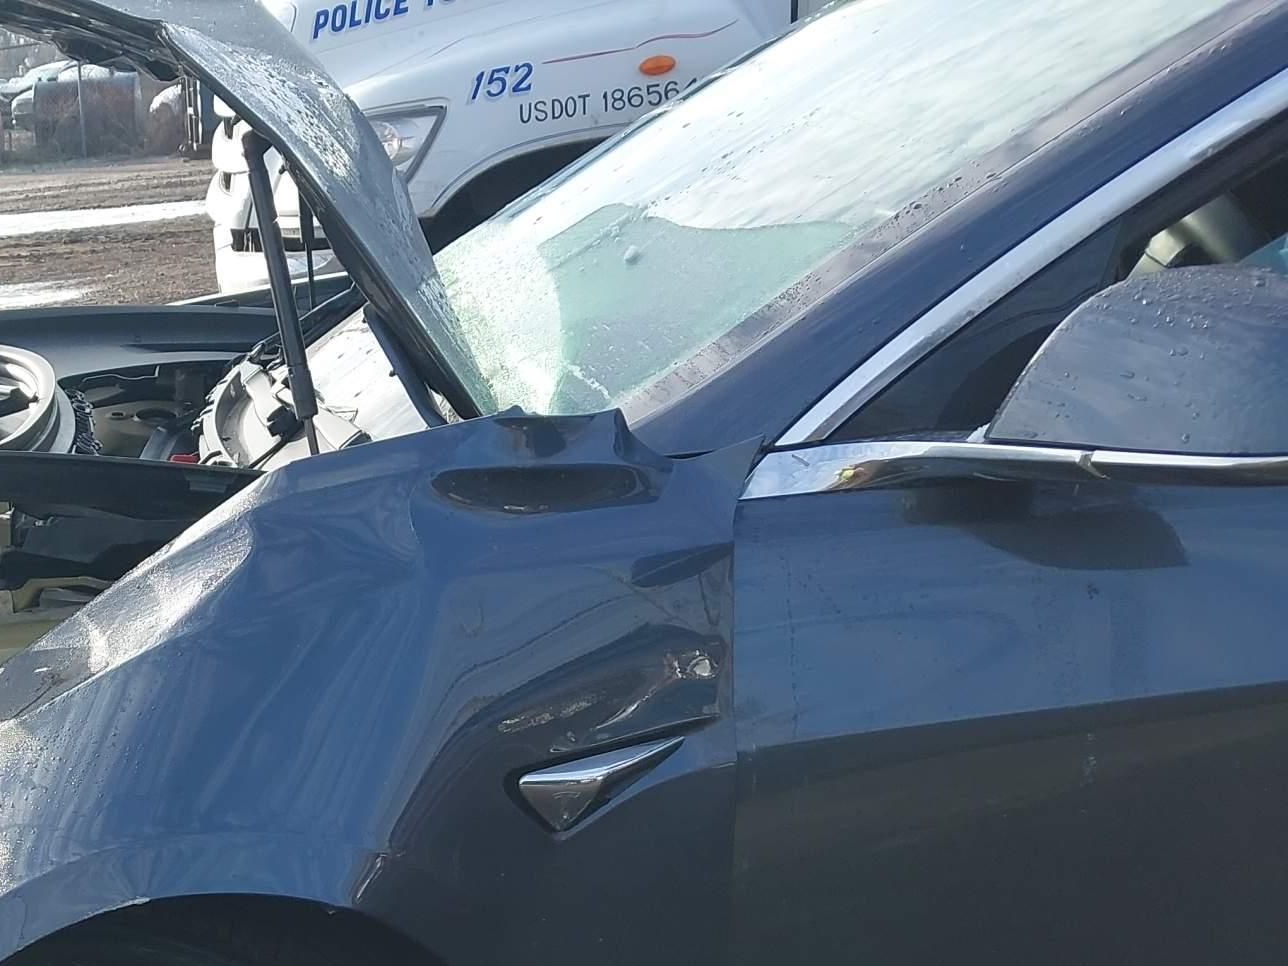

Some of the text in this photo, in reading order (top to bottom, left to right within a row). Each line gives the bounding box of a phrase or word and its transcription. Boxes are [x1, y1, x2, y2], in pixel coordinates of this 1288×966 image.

[312, 0, 409, 39] POLICE
[471, 62, 534, 100] 152
[519, 93, 591, 124] USDOT
